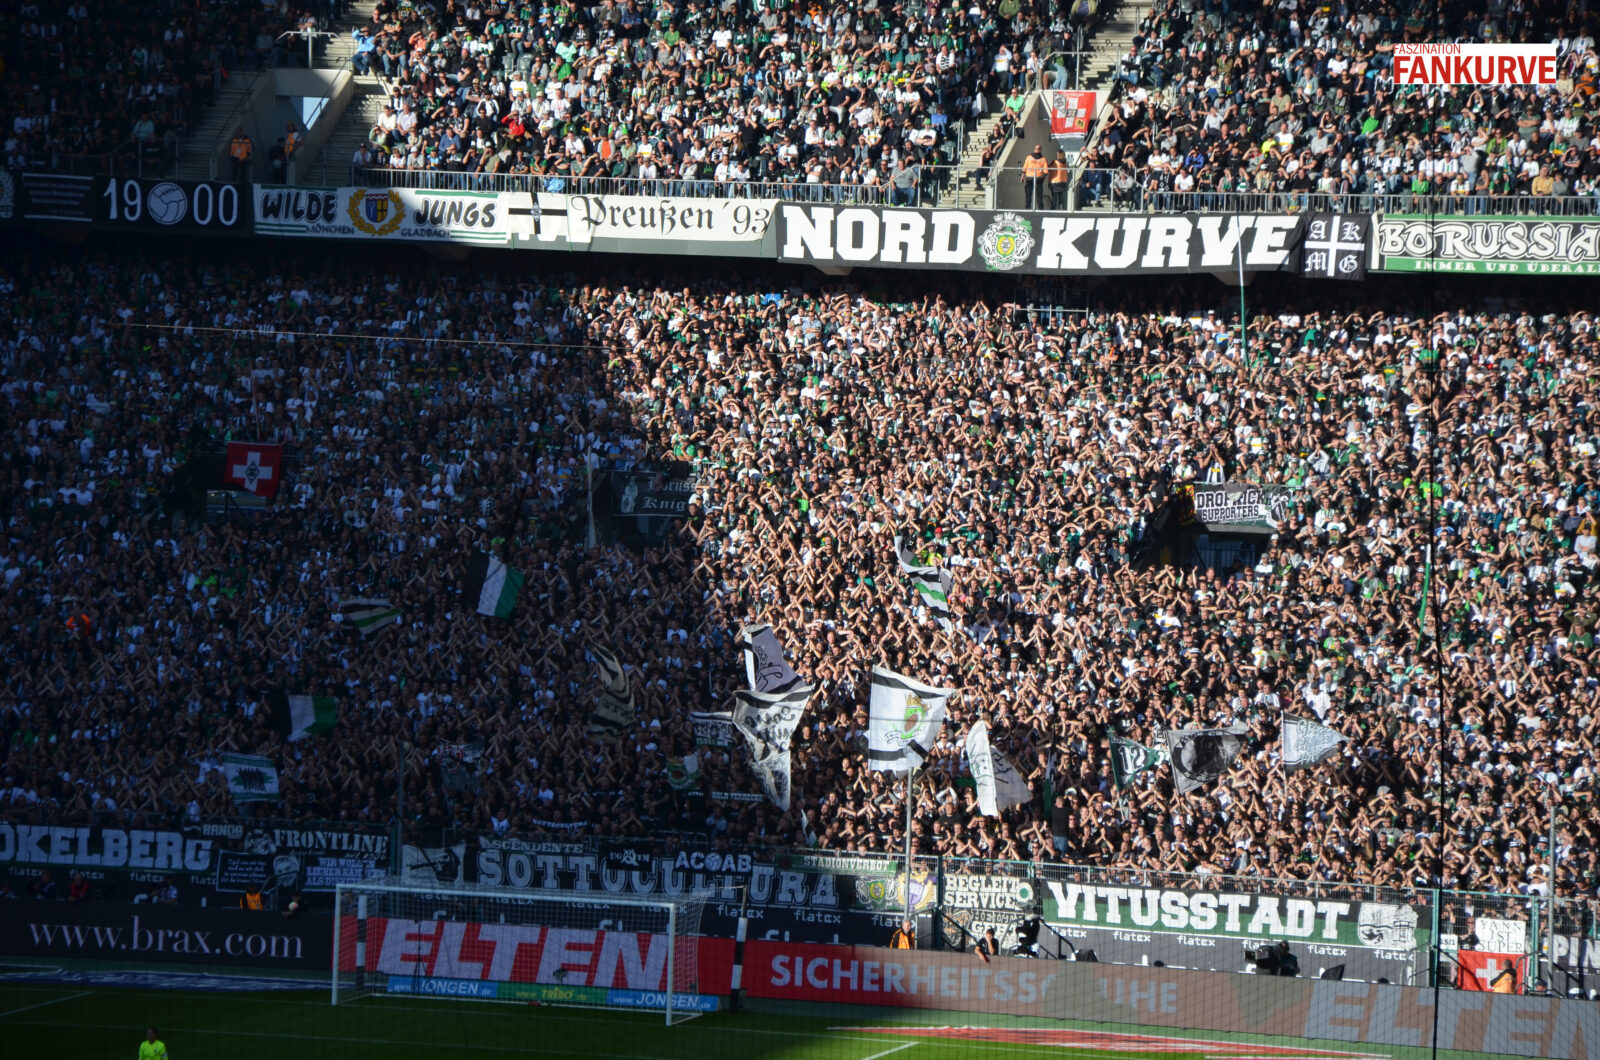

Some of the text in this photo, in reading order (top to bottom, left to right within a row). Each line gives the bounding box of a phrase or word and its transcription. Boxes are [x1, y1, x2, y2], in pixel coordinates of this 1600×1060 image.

[261, 190, 498, 228] WILDE JUNGS
[571, 195, 714, 235] Preußen
[305, 224, 450, 239] MÖNCHEN GLADBACH
[783, 205, 1300, 270] NORD KURVE
[1309, 220, 1329, 240] A
[1379, 221, 1600, 263] BORUSSIA
[1305, 251, 1328, 272] M
[1414, 260, 1600, 273] IMMER UND ÜBERAL
[1202, 505, 1260, 521] SUPPORTERS
[1118, 745, 1147, 775] 12
[272, 828, 389, 854] FRONTLINE
[803, 855, 890, 872] STADIONVERBOT
[944, 874, 1020, 894] BEGLEIT
[943, 892, 1018, 911] SERVICE
[1047, 881, 1351, 940] VITUSSTADT
[793, 910, 841, 925] flatex
[872, 914, 917, 929] flatx
[1480, 919, 1522, 931] YANN
[28, 915, 304, 959] www.brax.com
[1112, 930, 1151, 943] flatex
[1176, 935, 1216, 947] flatex
[1490, 930, 1513, 941] IST
[375, 917, 670, 991] ELTEN
[1307, 944, 1347, 956] flatex
[1478, 941, 1524, 953] SUPER
[770, 954, 1179, 1014] SICHERHEITSSUHE
[636, 993, 699, 1008] JONGEN
